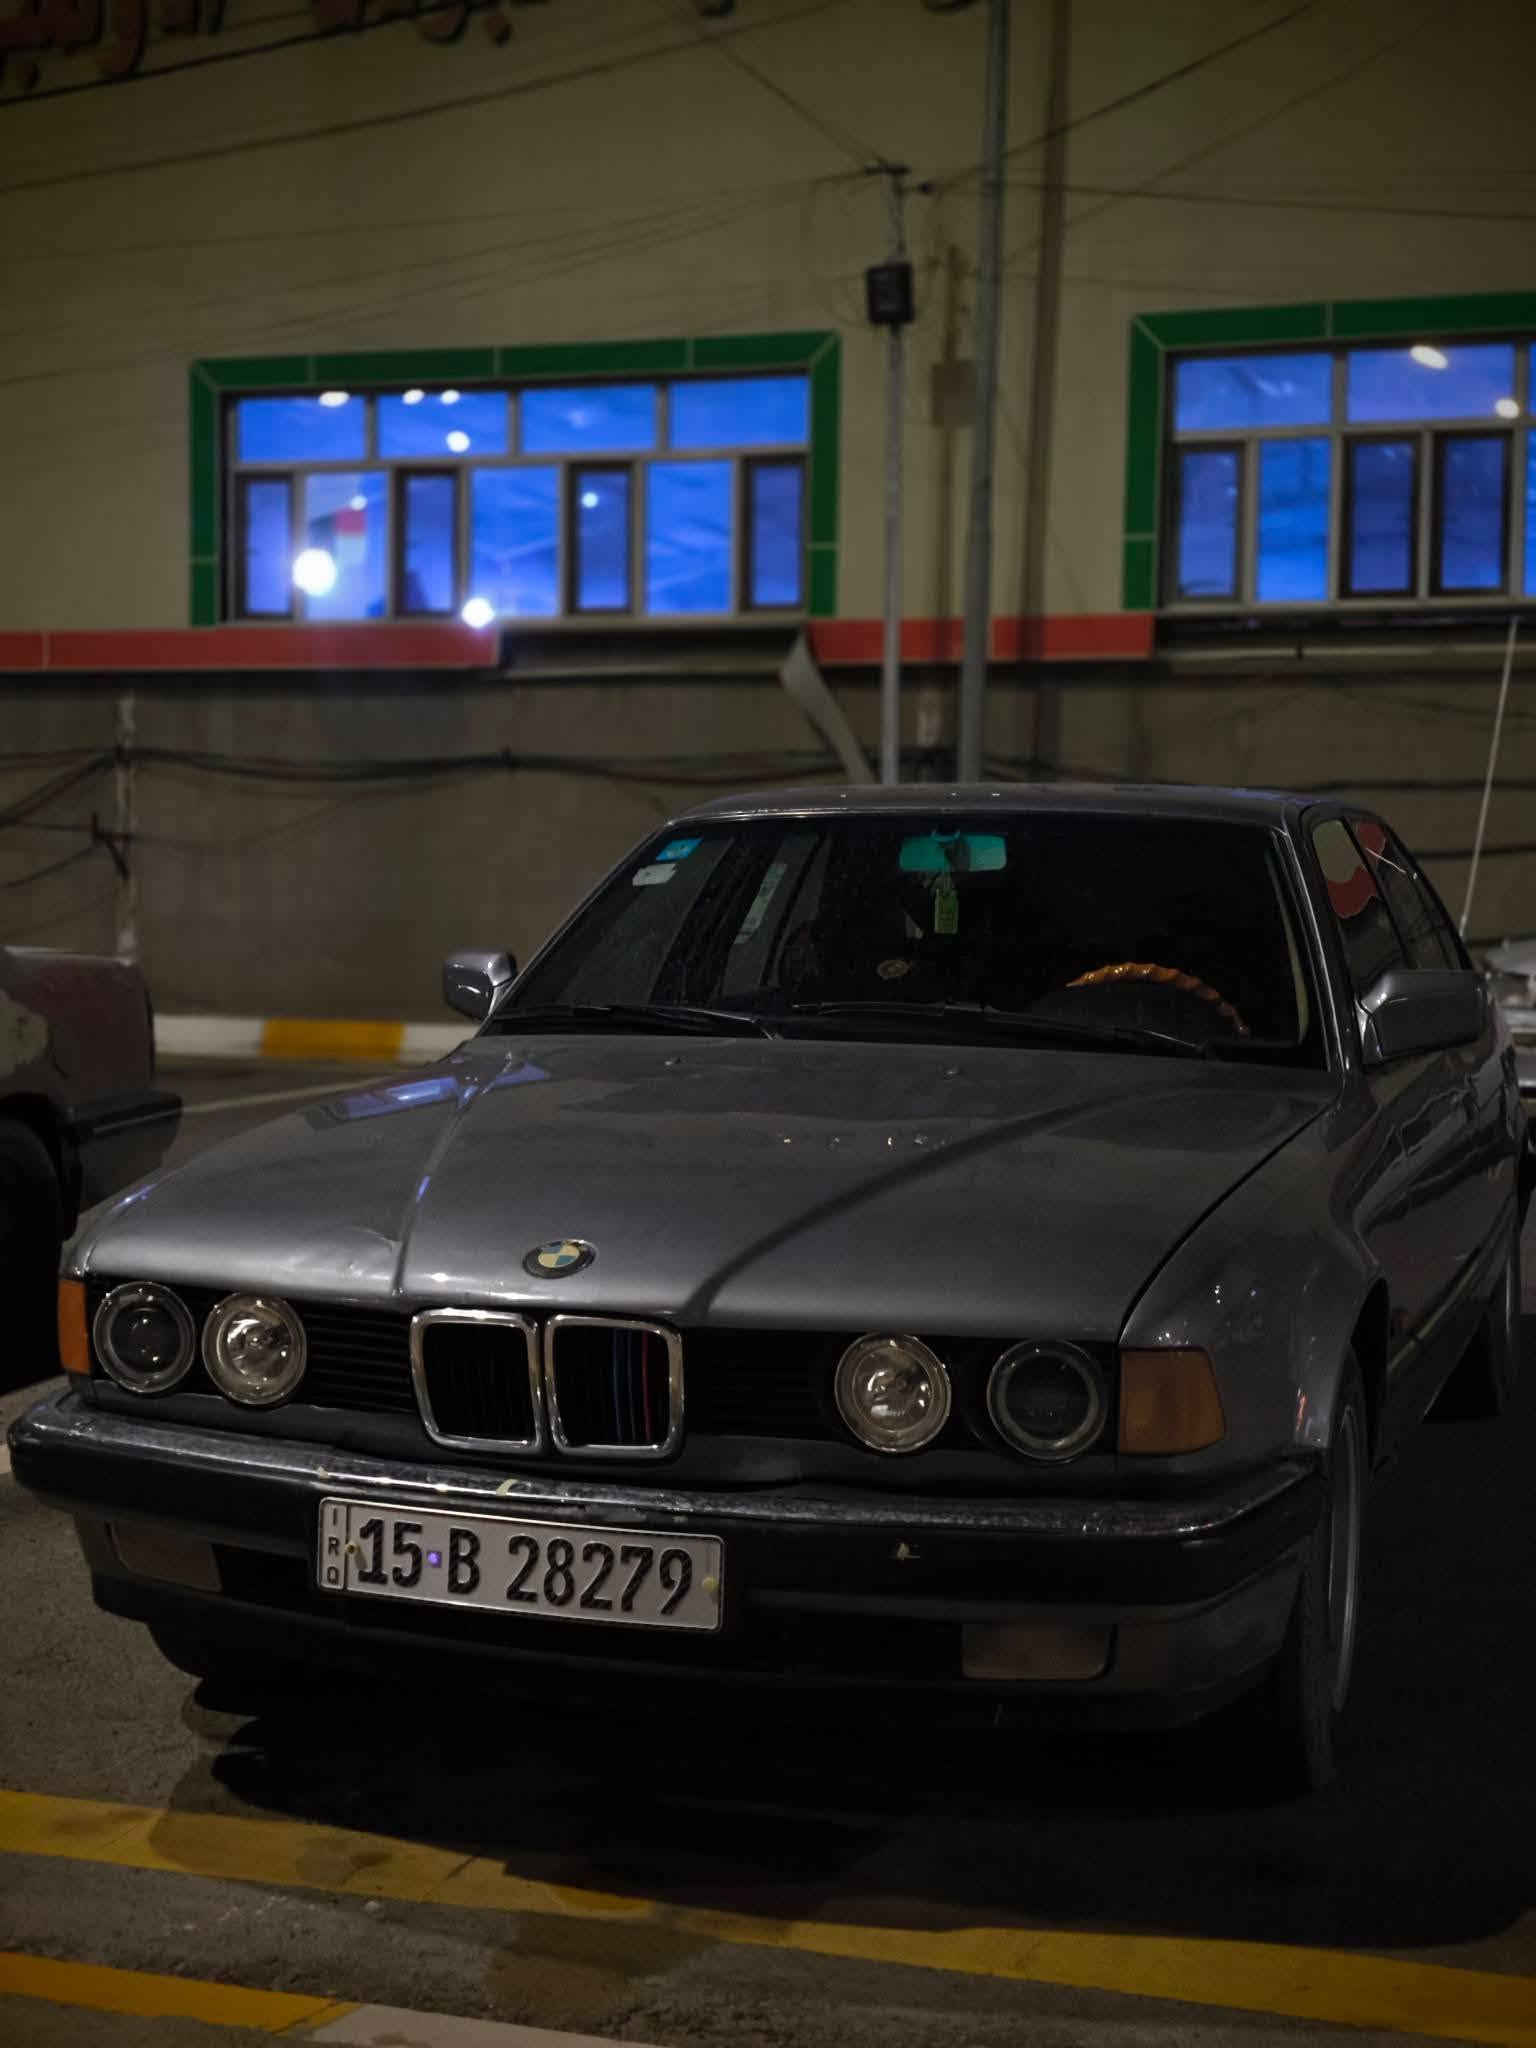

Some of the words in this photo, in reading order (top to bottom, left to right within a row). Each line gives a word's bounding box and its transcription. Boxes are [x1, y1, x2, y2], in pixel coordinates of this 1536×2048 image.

[358, 1518, 424, 1588] 15
[448, 1527, 481, 1595] B
[506, 1534, 693, 1616] 28279
